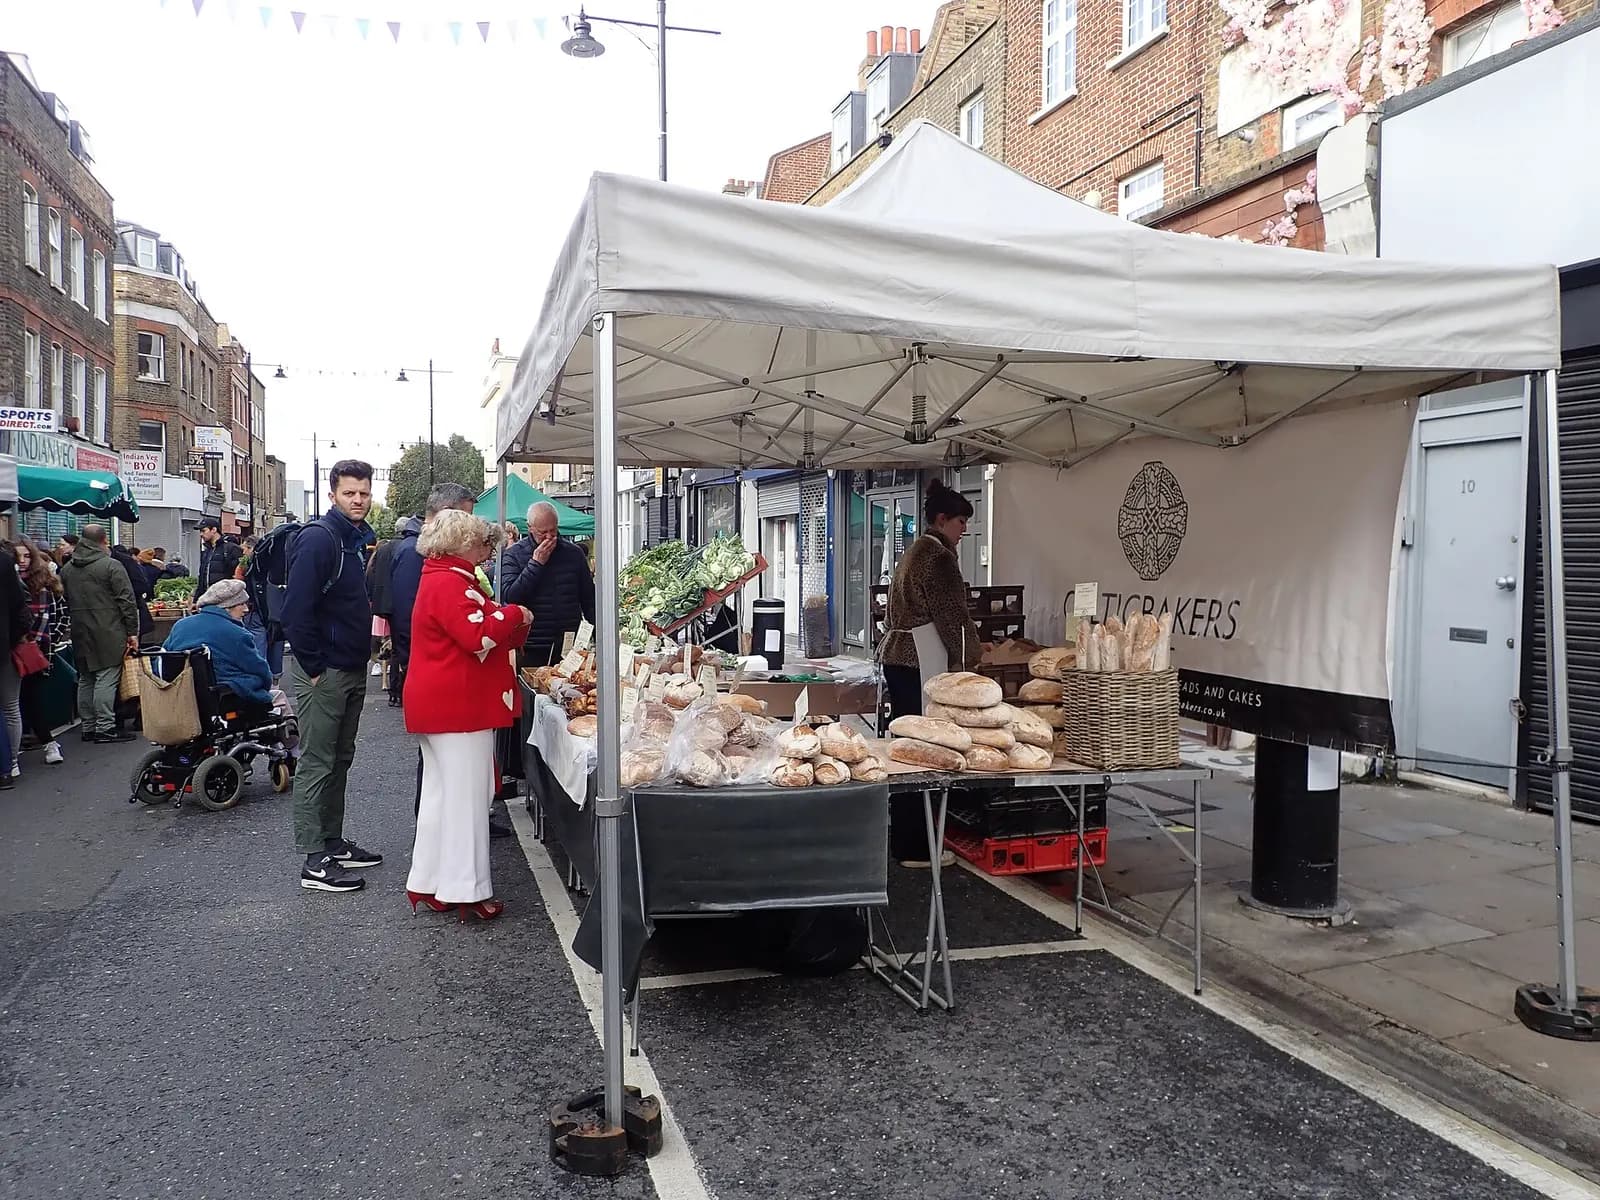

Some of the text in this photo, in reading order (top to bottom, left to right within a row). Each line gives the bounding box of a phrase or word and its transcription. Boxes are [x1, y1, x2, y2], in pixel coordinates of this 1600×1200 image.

[0, 409, 52, 421] SPORTS
[17, 430, 55, 464] INDIAN
[146, 453, 159, 462] Veg
[133, 461, 156, 471] BYO
[1460, 479, 1476, 494] 10
[1063, 590, 1241, 640] CTICBAKERS
[1203, 685, 1225, 699] AND
[1228, 689, 1262, 707] CAKES
[1179, 700, 1226, 718] akers.co.uk
